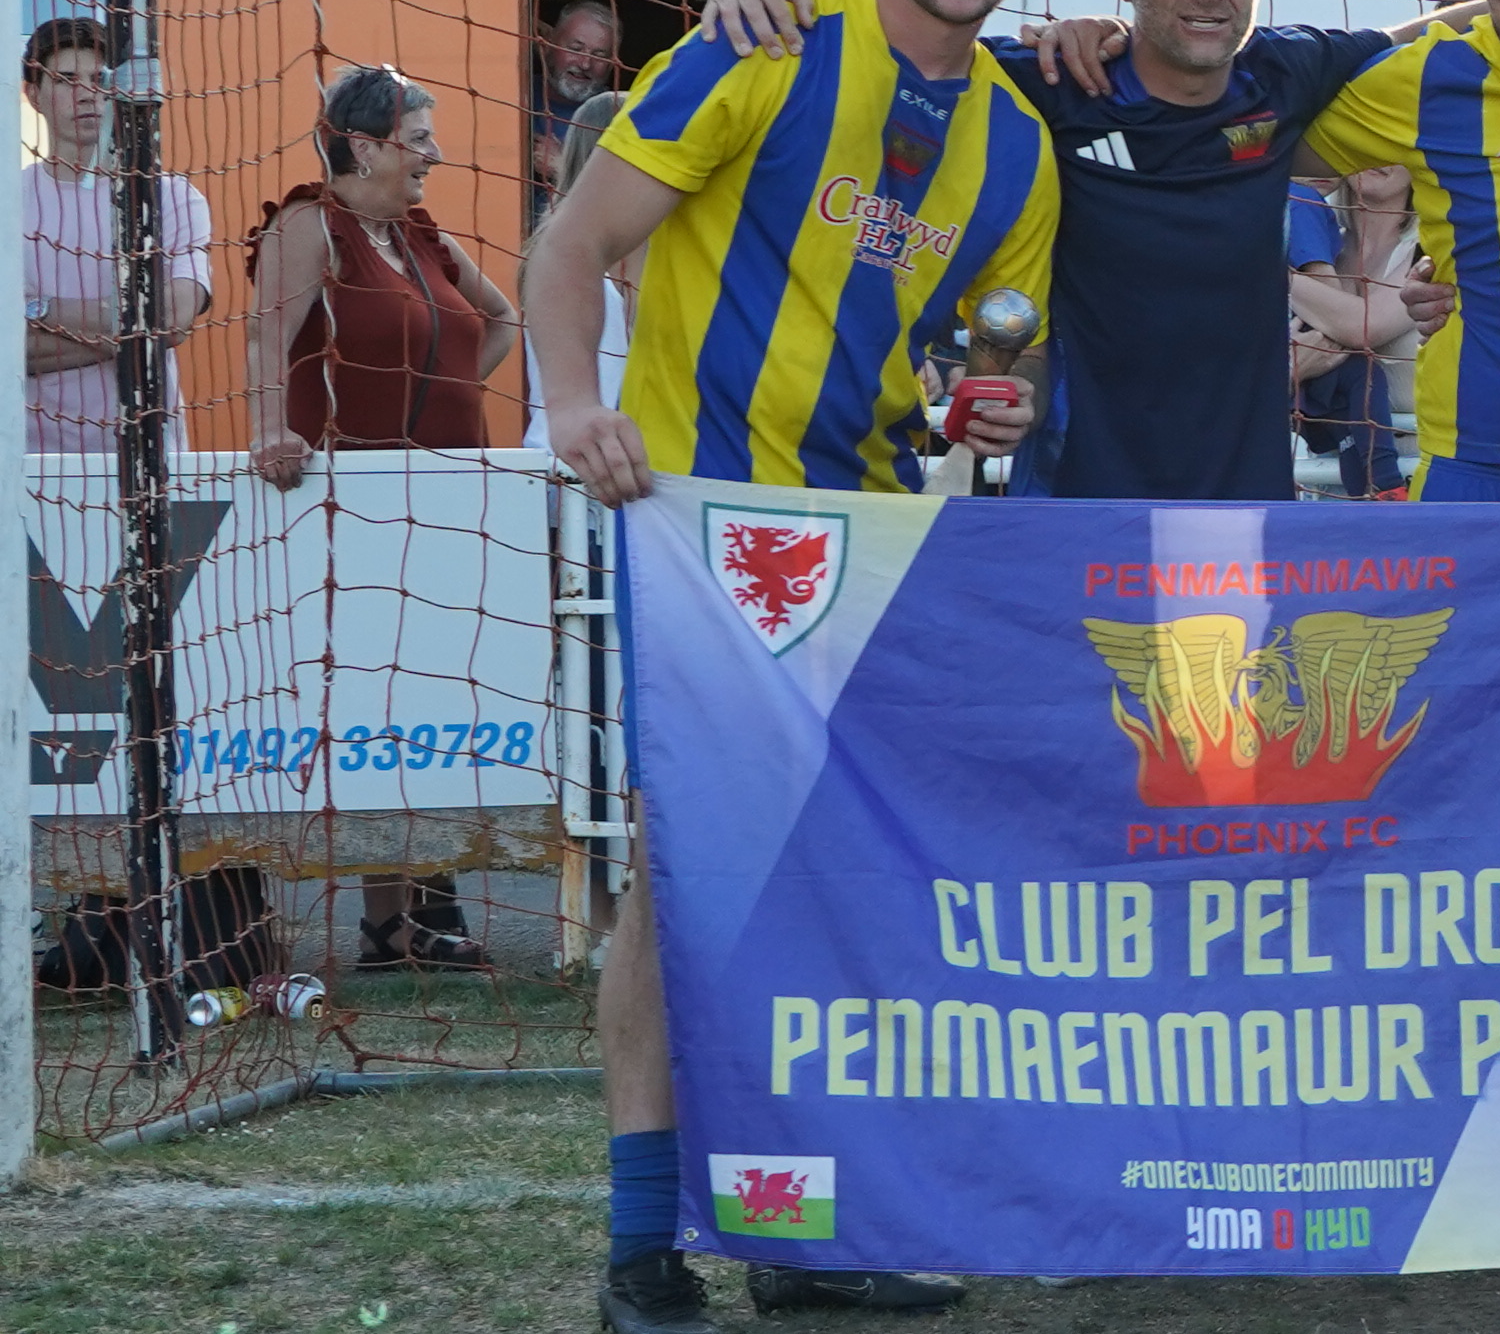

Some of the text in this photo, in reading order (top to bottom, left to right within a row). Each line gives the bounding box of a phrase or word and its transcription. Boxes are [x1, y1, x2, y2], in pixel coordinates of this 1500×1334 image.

[899, 88, 949, 121] EXILE
[1085, 556, 1457, 598] PENMAENMAWR
[339, 721, 535, 773] 339728
[1127, 816, 1399, 855] PHOENIX FC
[933, 877, 1154, 978] CLWB
[1189, 876, 1332, 976] PEL
[771, 995, 1434, 1107] PENMAENMAWR
[1121, 1157, 1434, 1193] #ONECLUBONECOMMUNITY
[1186, 1206, 1262, 1251] YMA
[1305, 1206, 1371, 1251] HYD
